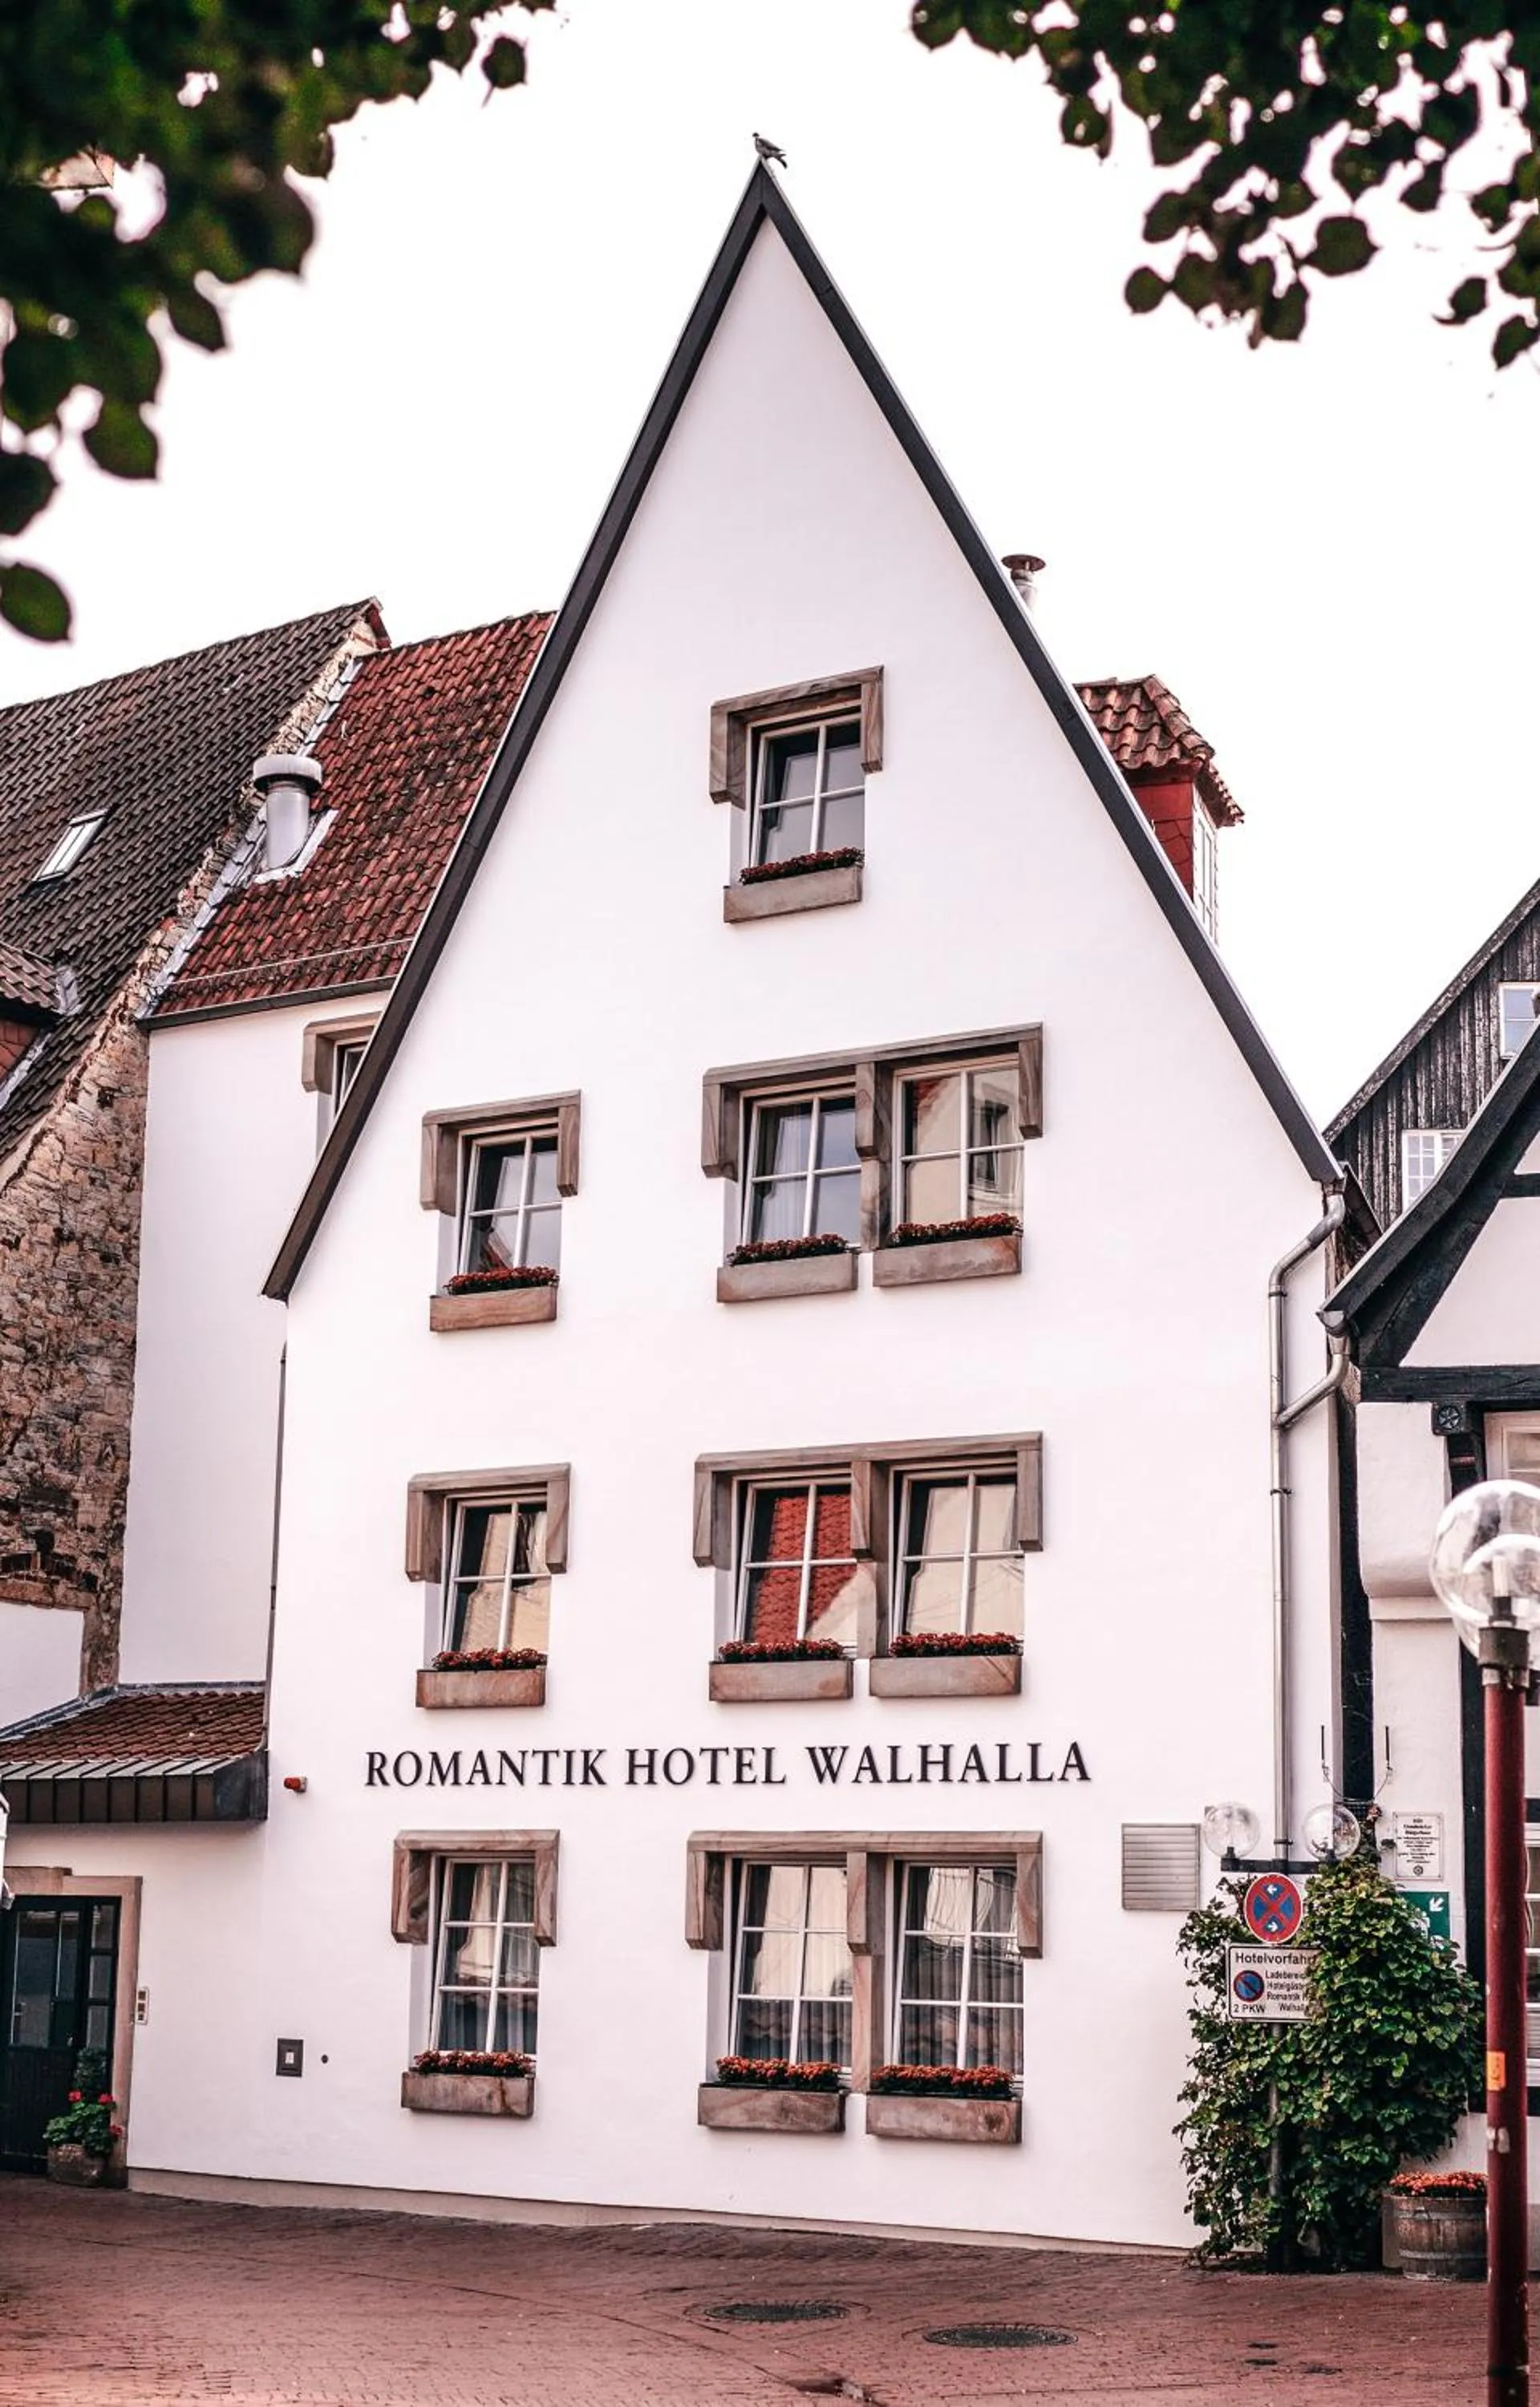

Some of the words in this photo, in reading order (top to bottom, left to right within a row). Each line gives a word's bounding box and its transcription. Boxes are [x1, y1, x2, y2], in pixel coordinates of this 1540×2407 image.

[364, 1748, 607, 1788] ROMANTIK
[624, 1746, 787, 1786] HOTEL
[804, 1740, 1092, 1784] WALHALLA
[1265, 1970, 1307, 1979] Ladebereic
[1266, 1982, 1305, 1991] Hotelgäst
[1234, 2003, 1239, 2013] 2
[1242, 2004, 1265, 2014] PKW
[1279, 2003, 1307, 2011] Walhall
